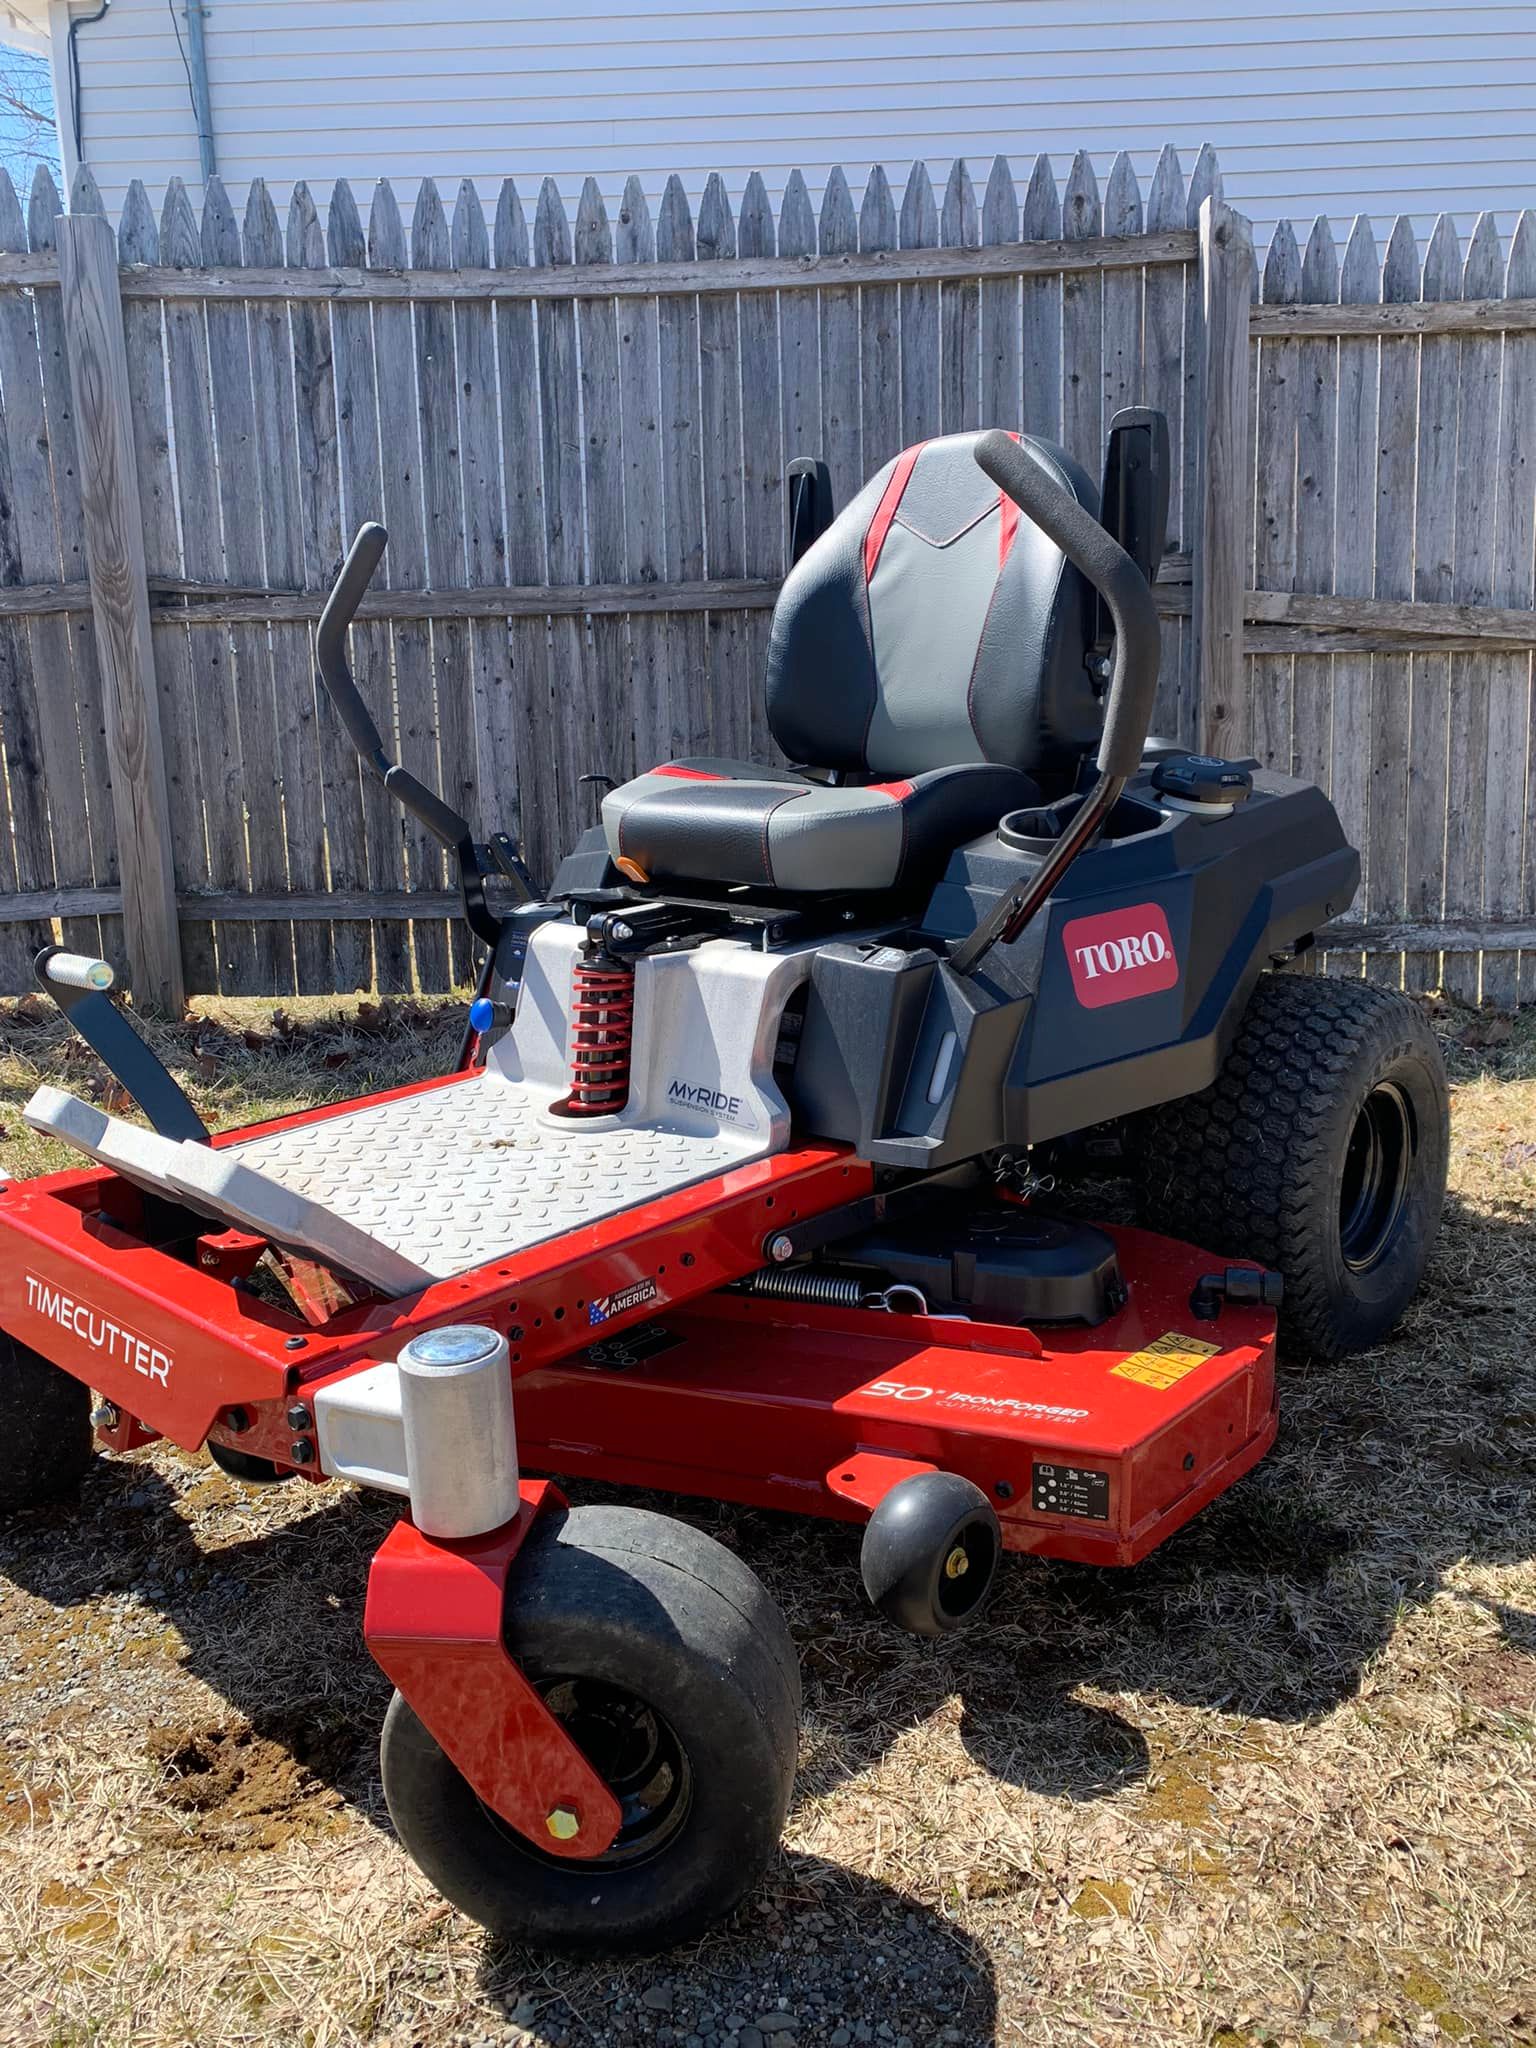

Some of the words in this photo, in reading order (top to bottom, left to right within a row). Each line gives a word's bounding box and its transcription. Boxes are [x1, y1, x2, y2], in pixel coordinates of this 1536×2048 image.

[1075, 931, 1165, 979] TORO
[710, 1110, 736, 1121] SYSTEM
[610, 1285, 656, 1315] AMERICA
[25, 1275, 169, 1388] TIMECUTTER
[935, 1400, 1007, 1415] CUTTING
[1009, 1410, 1077, 1424] SYSTEM
